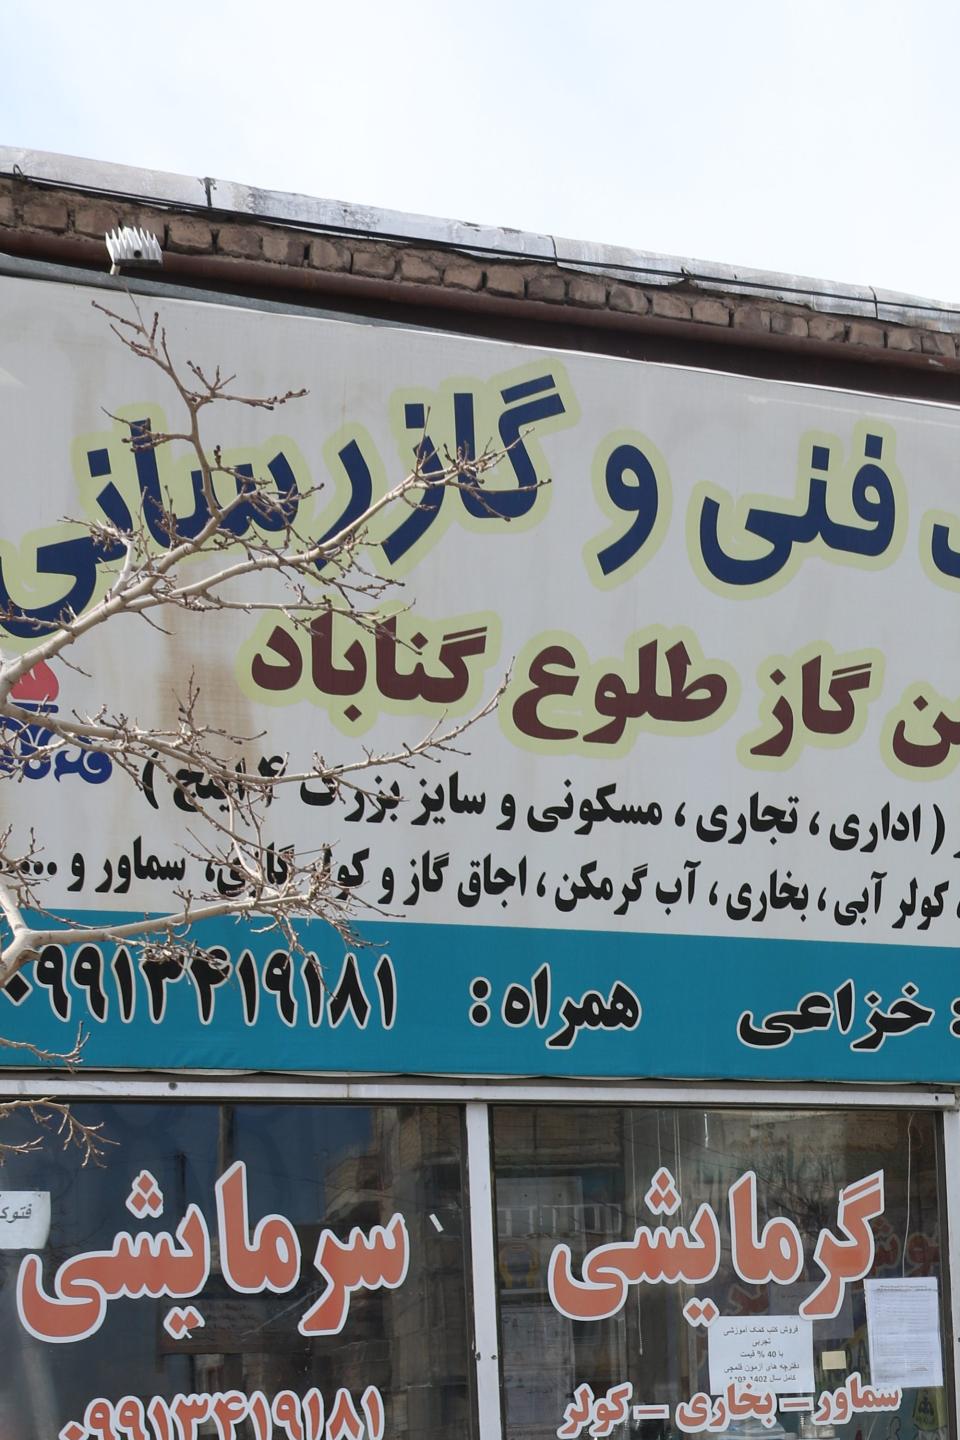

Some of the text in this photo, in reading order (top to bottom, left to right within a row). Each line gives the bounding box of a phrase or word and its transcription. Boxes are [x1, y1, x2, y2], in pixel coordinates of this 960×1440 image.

[596, 443, 660, 576] و
[699, 433, 896, 586] فنی
[250, 610, 488, 723] گناباد
[512, 639, 729, 745] طلوع
[749, 654, 873, 757] گاز
[410, 770, 486, 826] سایز
[495, 793, 517, 831] و
[526, 778, 663, 836] مسکونی
[695, 791, 800, 846] تجاری
[829, 801, 922, 853] اداری
[66, 852, 86, 892] و
[94, 835, 187, 893] سماور
[377, 866, 396, 905] و
[401, 849, 450, 906] گاز
[457, 852, 528, 908] اجاق
[554, 859, 649, 916] گرمکن
[655, 859, 702, 916] آب
[725, 869, 809, 923] بخاری
[833, 870, 888, 926] آبی
[891, 877, 950, 930] کولر
[501, 962, 642, 1049] همراه
[737, 979, 935, 1052] خزاعی
[16, 1161, 410, 1342] سرمایشی
[548, 1167, 885, 1326] گرمایشی
[558, 1383, 632, 1439] کولر
[676, 1381, 776, 1432] بخاری
[813, 1373, 901, 1425] سماور
